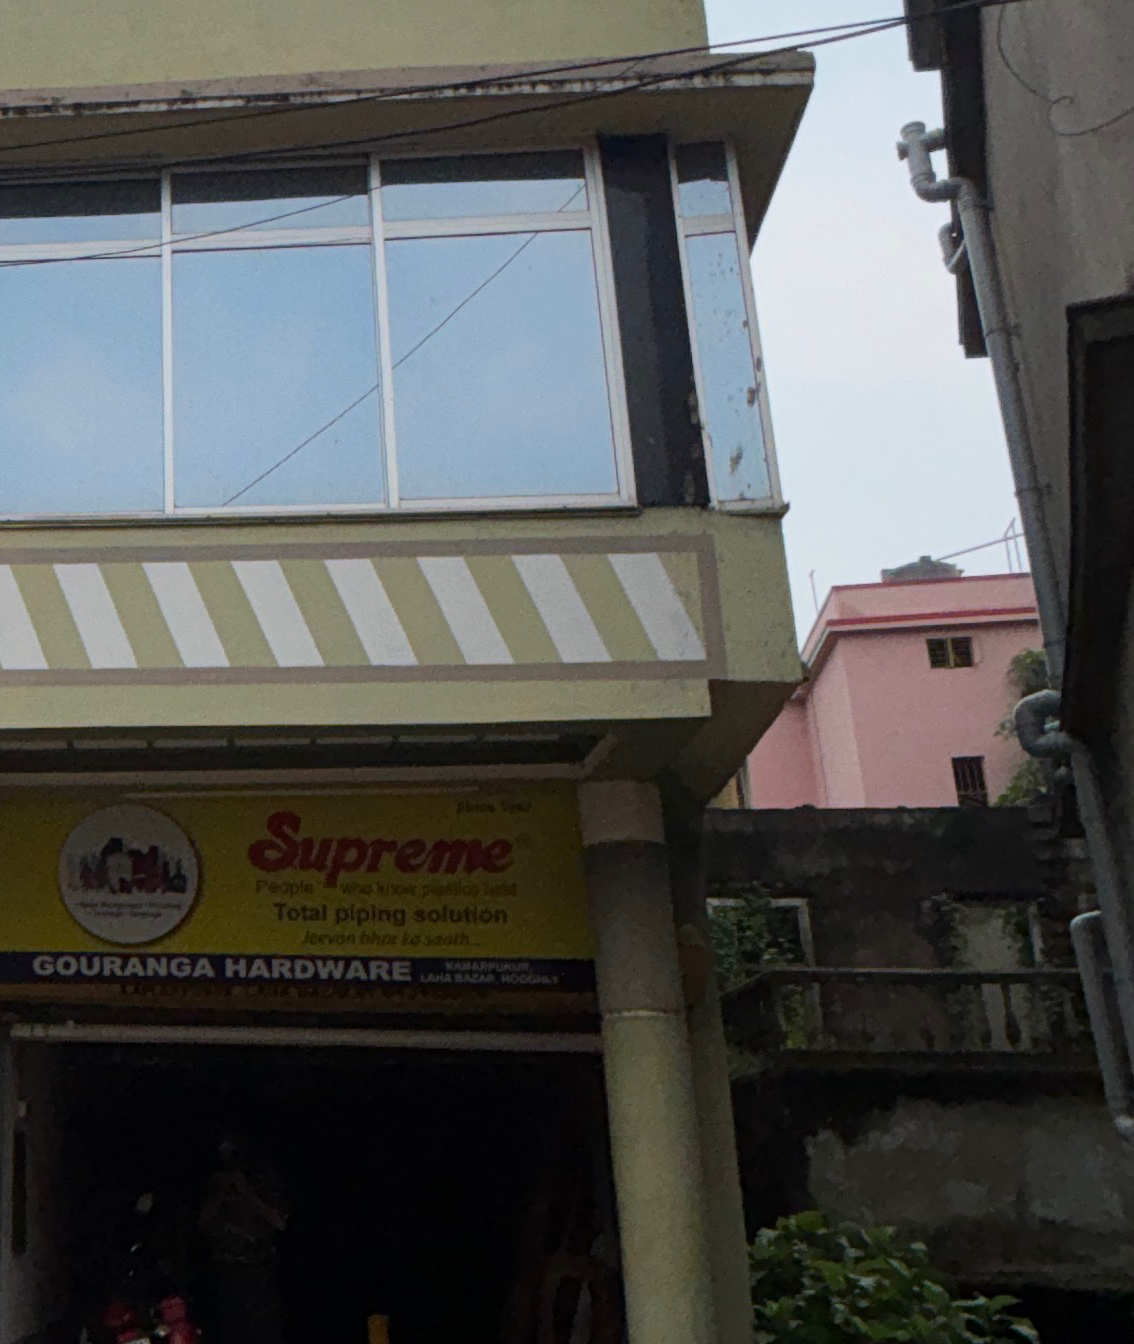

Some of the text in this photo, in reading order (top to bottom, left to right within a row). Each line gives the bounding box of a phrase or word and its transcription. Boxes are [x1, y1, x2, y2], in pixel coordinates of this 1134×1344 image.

[247, 810, 514, 888] Supreme
[255, 880, 314, 897] People
[273, 903, 508, 927] Total piping solution
[32, 955, 412, 982] GOURANGA HARDWARE
